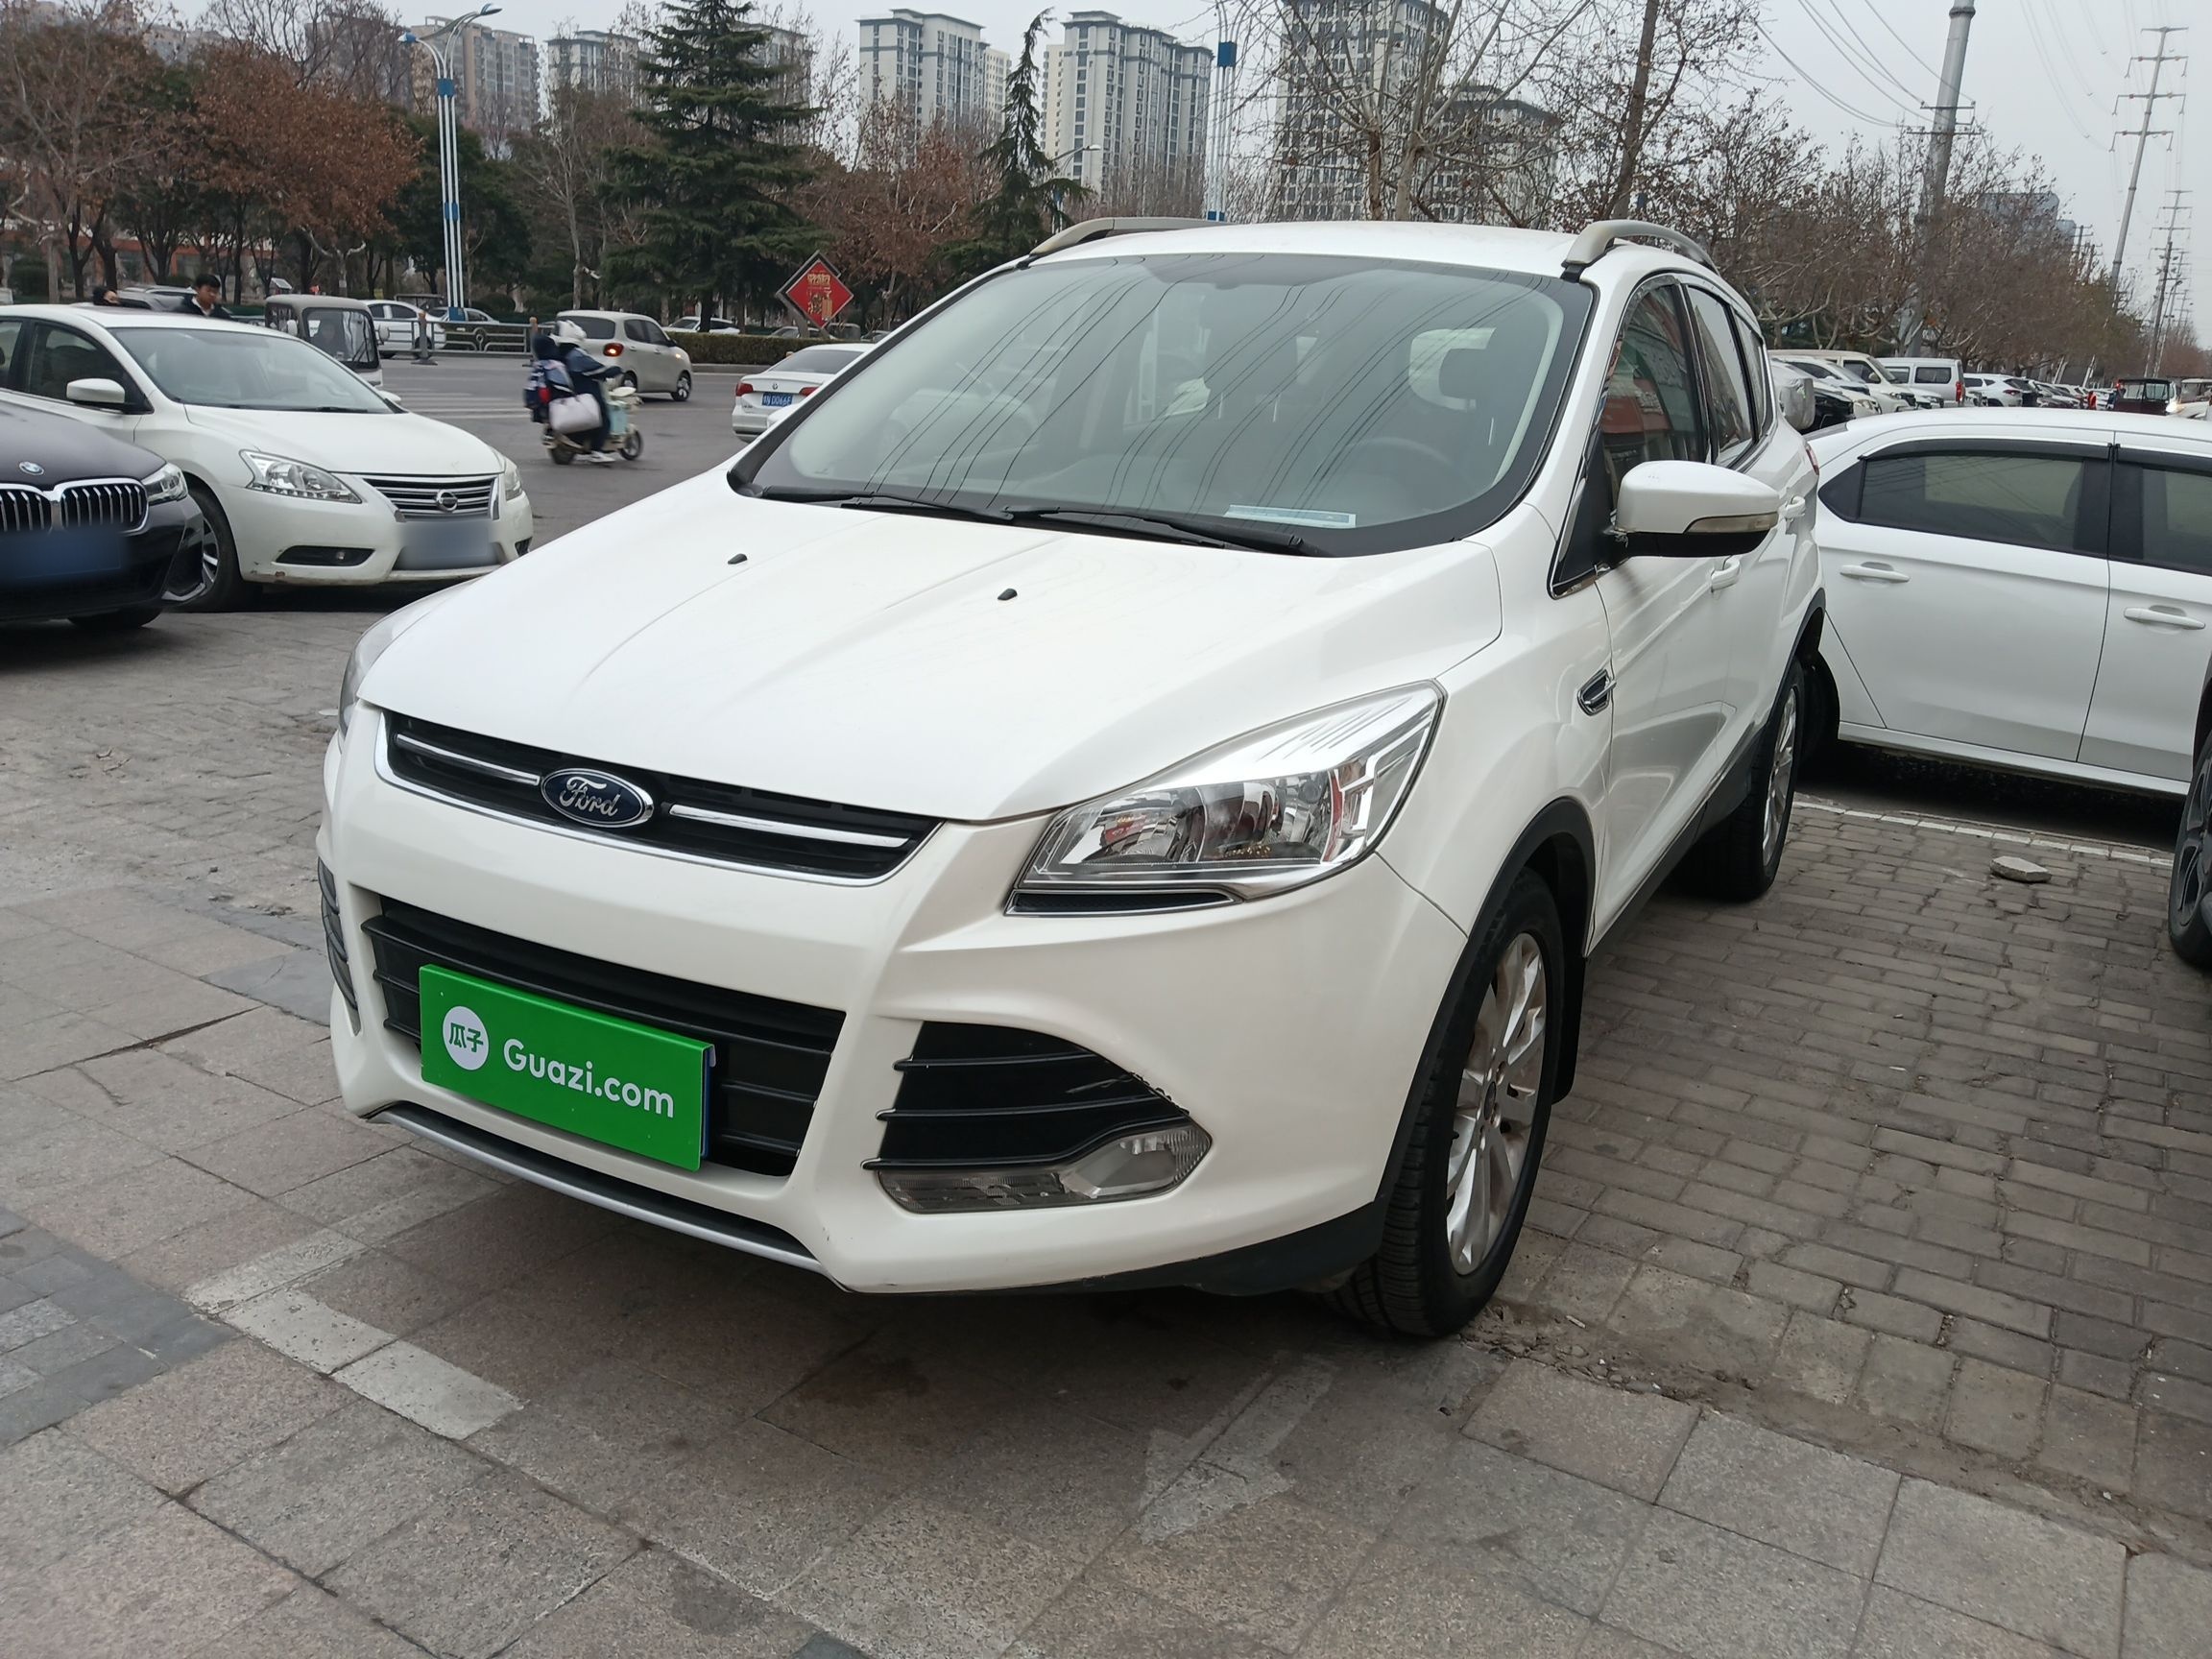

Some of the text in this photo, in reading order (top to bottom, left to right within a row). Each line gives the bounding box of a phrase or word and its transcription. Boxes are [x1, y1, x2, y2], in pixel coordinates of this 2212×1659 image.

[559, 776, 622, 817] Ford
[448, 1022, 484, 1053] 瓜子
[503, 1038, 674, 1118] Guazi.com
